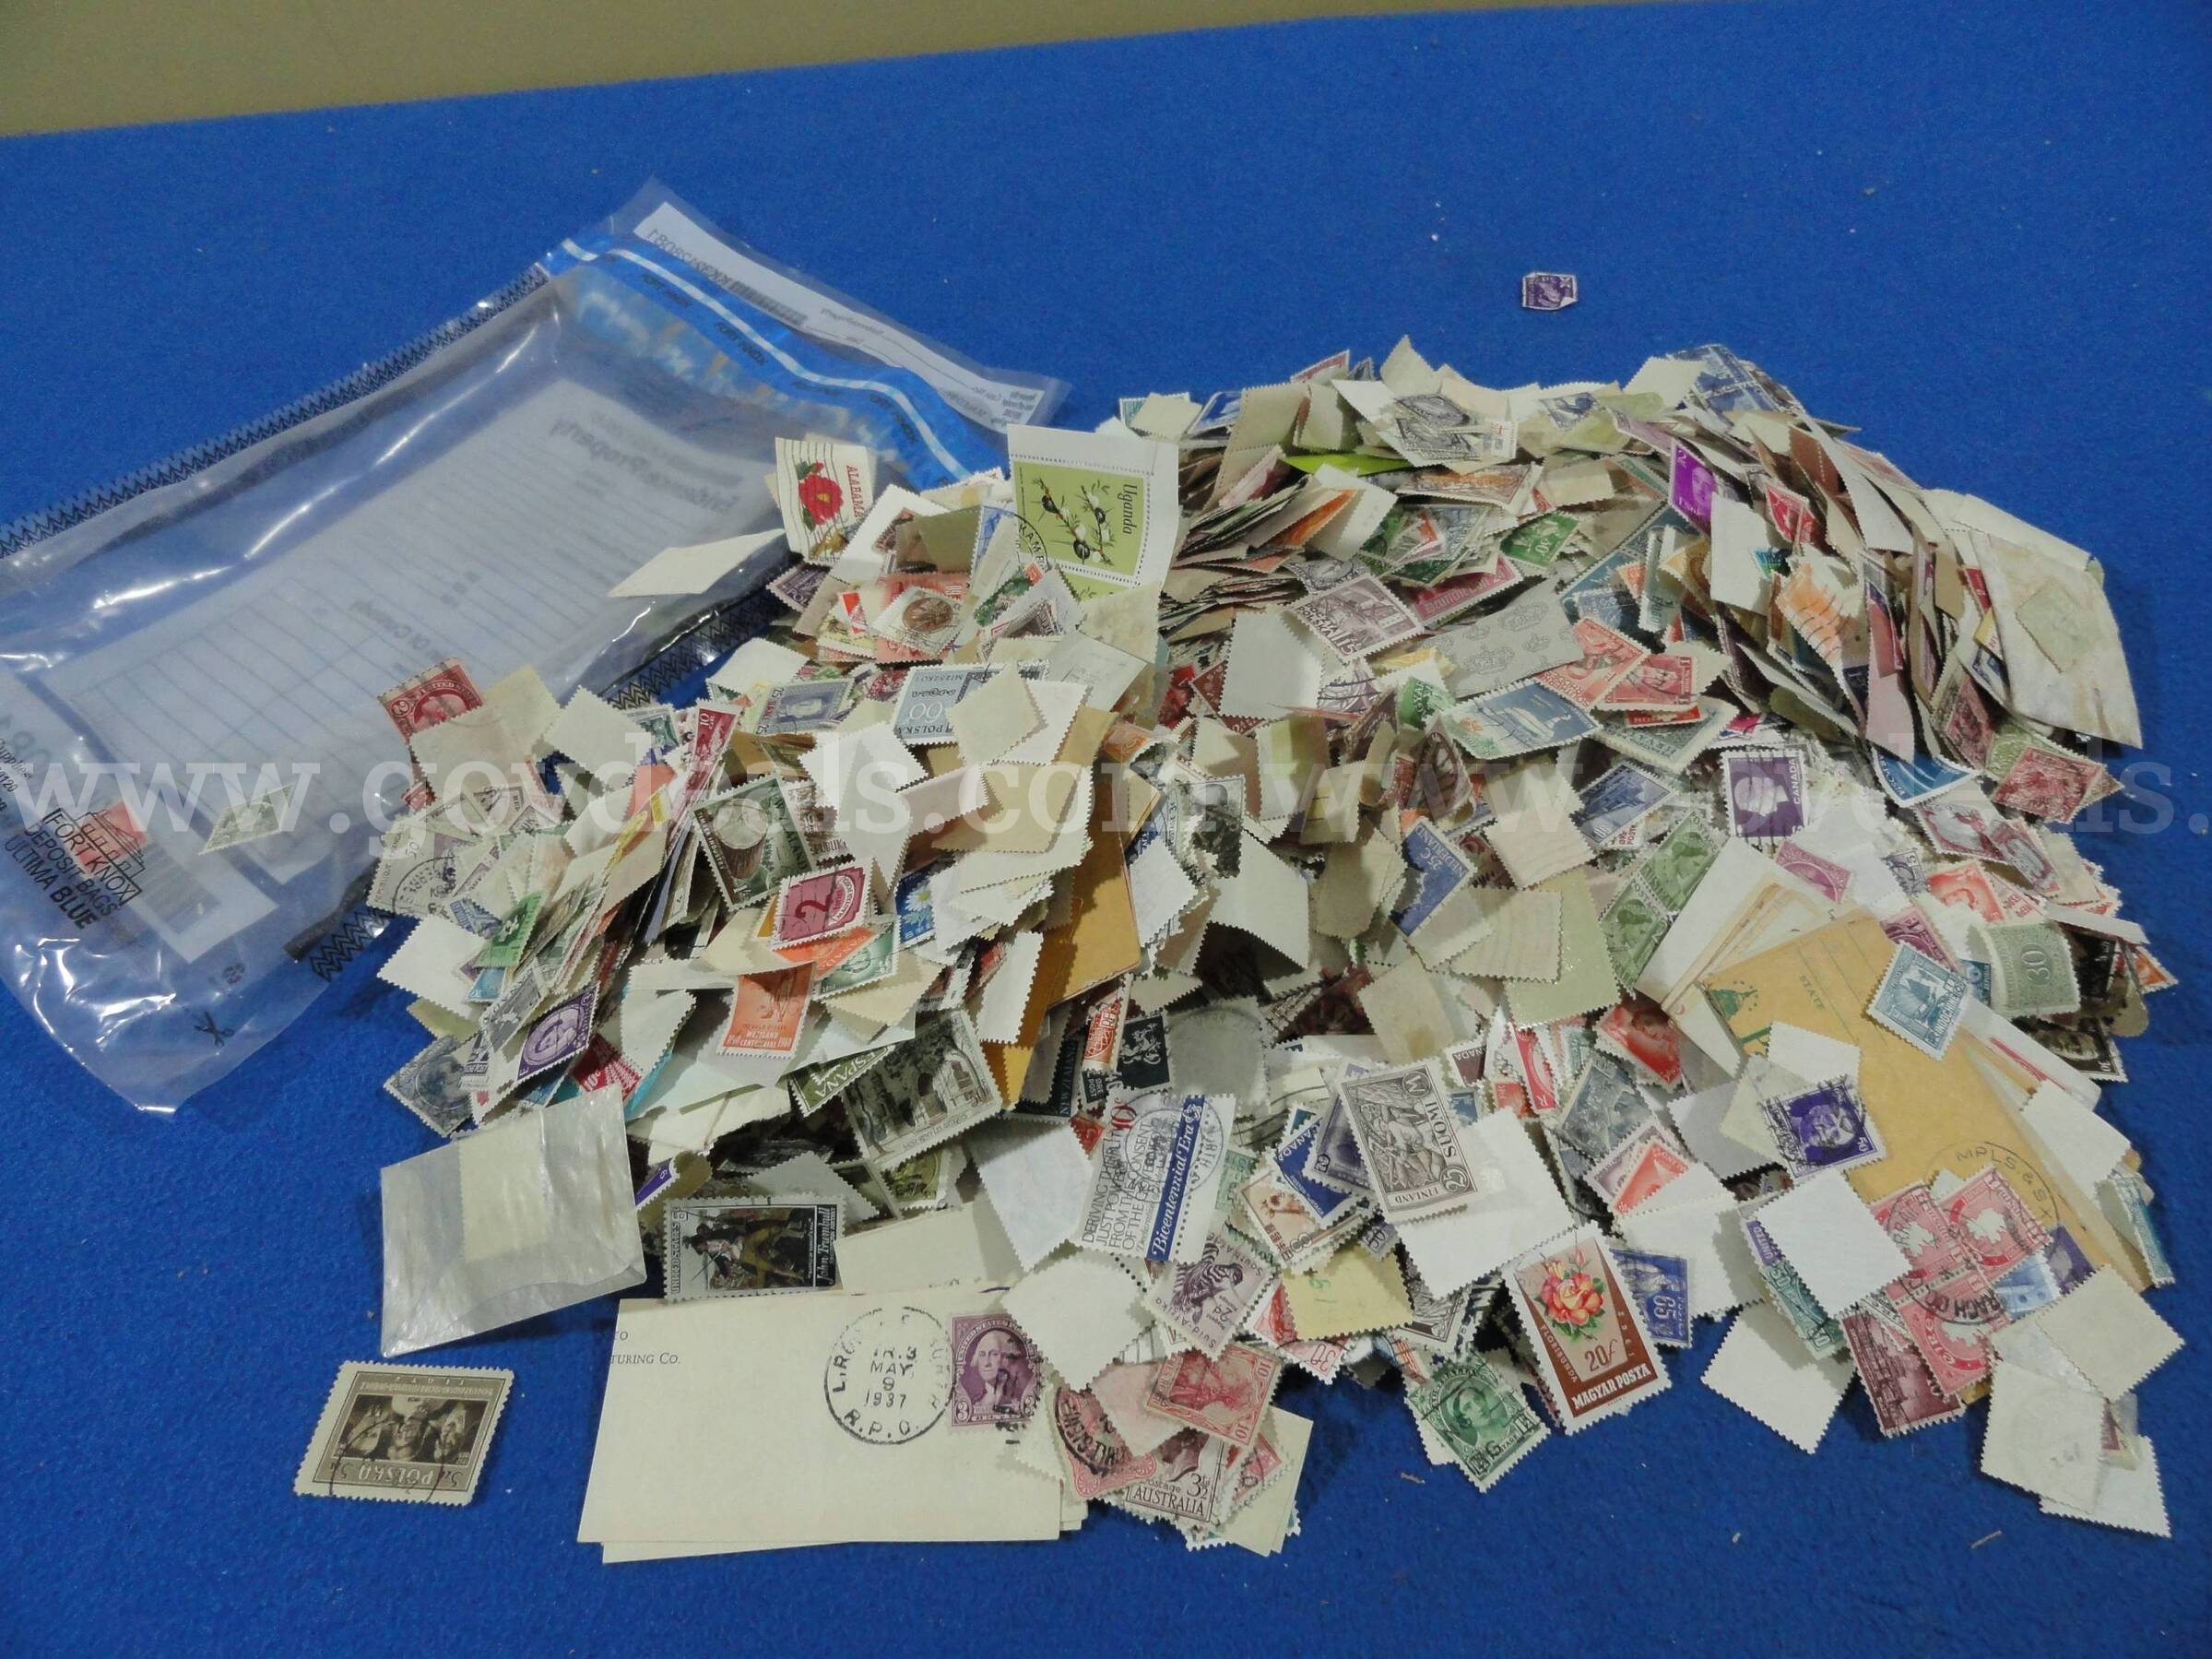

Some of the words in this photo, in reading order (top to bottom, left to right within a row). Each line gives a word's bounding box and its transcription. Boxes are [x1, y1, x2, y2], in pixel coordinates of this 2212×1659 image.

[1117, 483, 1139, 536] Uganda
[1297, 606, 1331, 636] POLSKA
[907, 701, 943, 724] 60
[897, 724, 946, 735] POLSKA
[1788, 758, 1802, 805] CANADA
[47, 813, 93, 857] FORT
[84, 855, 136, 901] KNOX
[1415, 821, 1468, 877] NEDERLAND
[5, 835, 55, 891] ULTIMA
[50, 885, 97, 930] BLUE
[25, 824, 85, 879] DEPOSIT
[76, 879, 118, 917] BAGS
[1933, 993, 1961, 1036] INDOCHINE
[1425, 1100, 1458, 1160] SUOMI
[1107, 1206, 1130, 1249] FROM
[1126, 1120, 1152, 1180] CONSENT
[1149, 1154, 1188, 1257] Bicentennial
[1175, 1122, 1195, 1155] Era
[1394, 1186, 1440, 1204] FINLAND
[1444, 1167, 1469, 1192] 25
[817, 1206, 833, 1251] Trumbull
[1081, 1182, 1107, 1244] DERIVING
[1095, 1211, 1114, 1247] JUST
[1126, 1200, 1144, 1229] THE
[670, 1222, 681, 1252] STATES
[1120, 1226, 1138, 1251] OF
[1752, 1226, 1774, 1260] UNITED
[670, 1255, 681, 1293] UNITED
[1652, 1295, 1677, 1321] 65
[658, 1353, 680, 1366] Co.
[869, 1361, 909, 1377] MAY
[1258, 1360, 1273, 1379] 10
[865, 1391, 907, 1410] 1937
[1571, 1381, 1617, 1411] MAGYAR
[1615, 1363, 1652, 1389] POSTA
[1234, 1423, 1249, 1440] 10
[358, 1463, 435, 1486] POLSKA
[1133, 1486, 1206, 1518] AUSTRALIA
